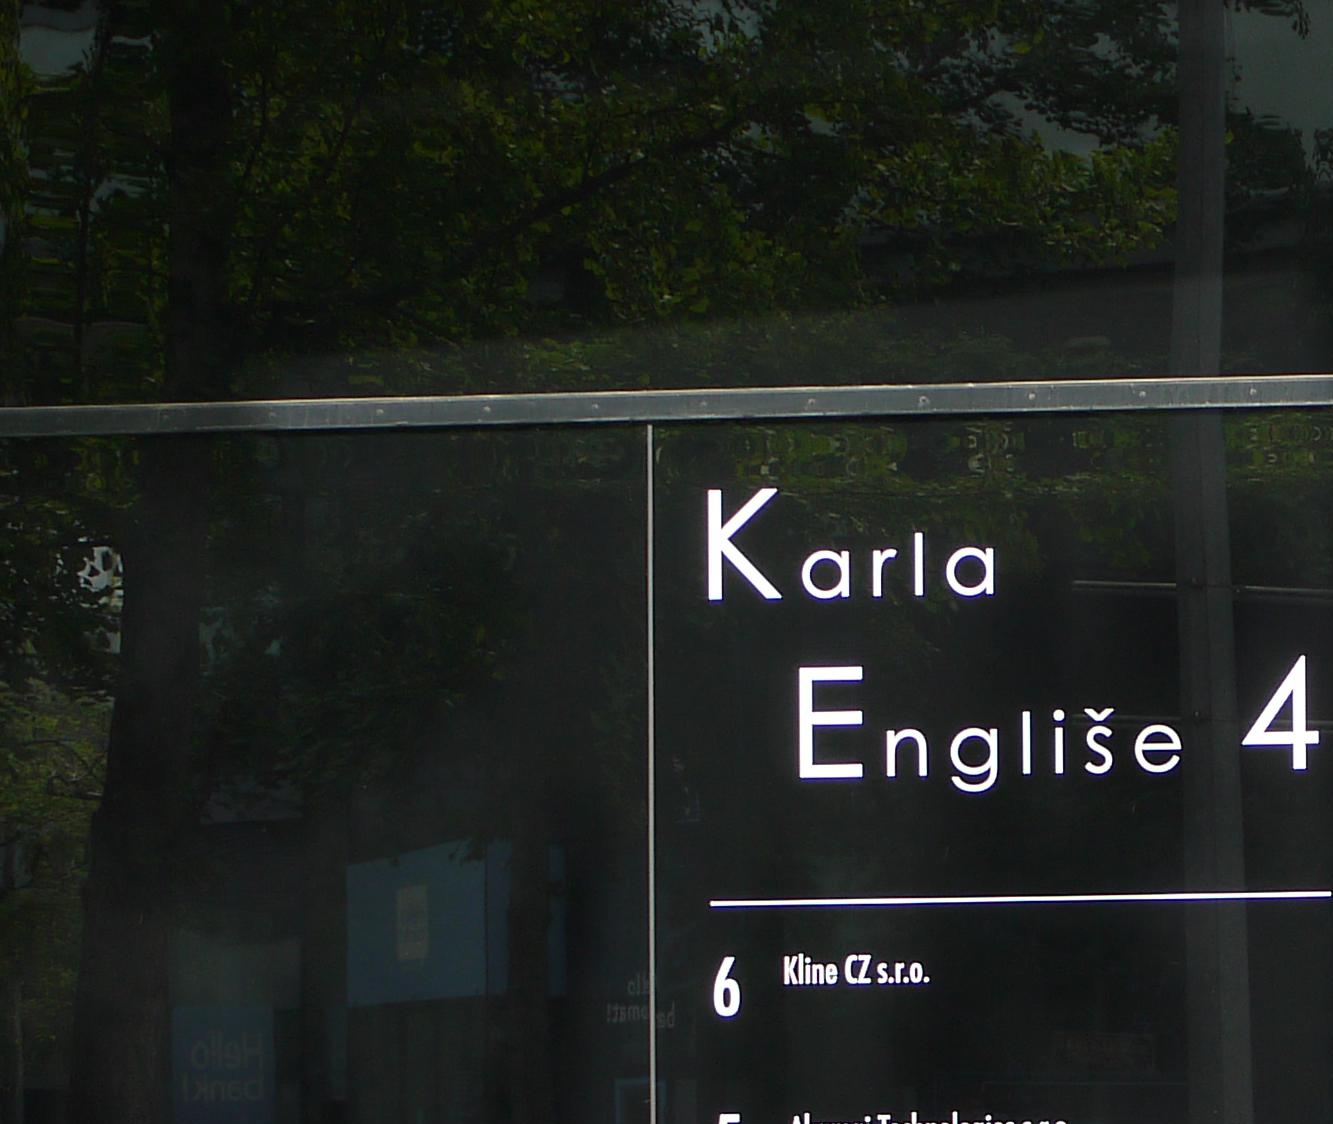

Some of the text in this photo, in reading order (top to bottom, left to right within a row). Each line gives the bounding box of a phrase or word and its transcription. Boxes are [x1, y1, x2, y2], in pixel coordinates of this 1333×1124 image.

[707, 487, 995, 601] Karla
[798, 654, 1320, 793] Engliše 4
[712, 952, 931, 1017] 6 Kline CZ s.r.o.
